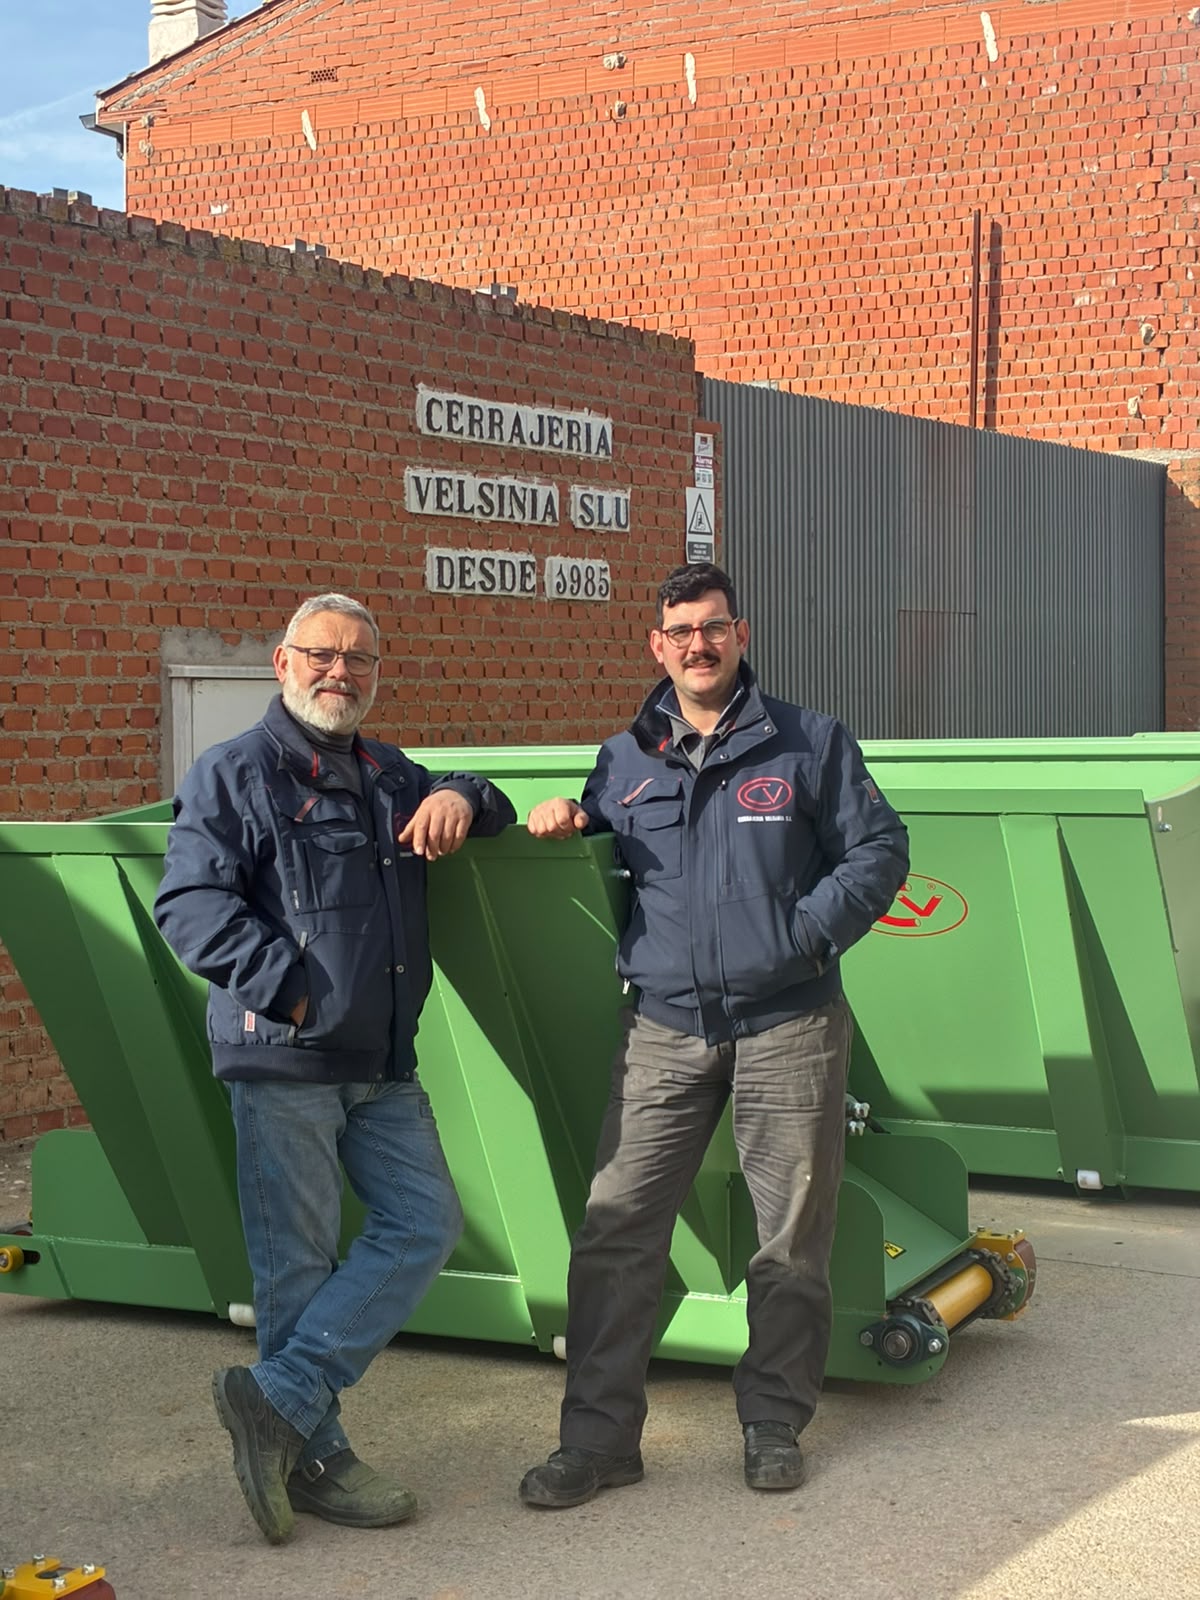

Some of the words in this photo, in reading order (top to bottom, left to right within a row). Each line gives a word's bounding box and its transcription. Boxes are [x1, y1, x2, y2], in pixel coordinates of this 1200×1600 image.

[426, 398, 612, 456] CERRAJERIA
[412, 475, 559, 522] VELSINIA
[579, 493, 630, 529] SLU
[436, 555, 536, 593] DESDE
[556, 563, 610, 598] 1985
